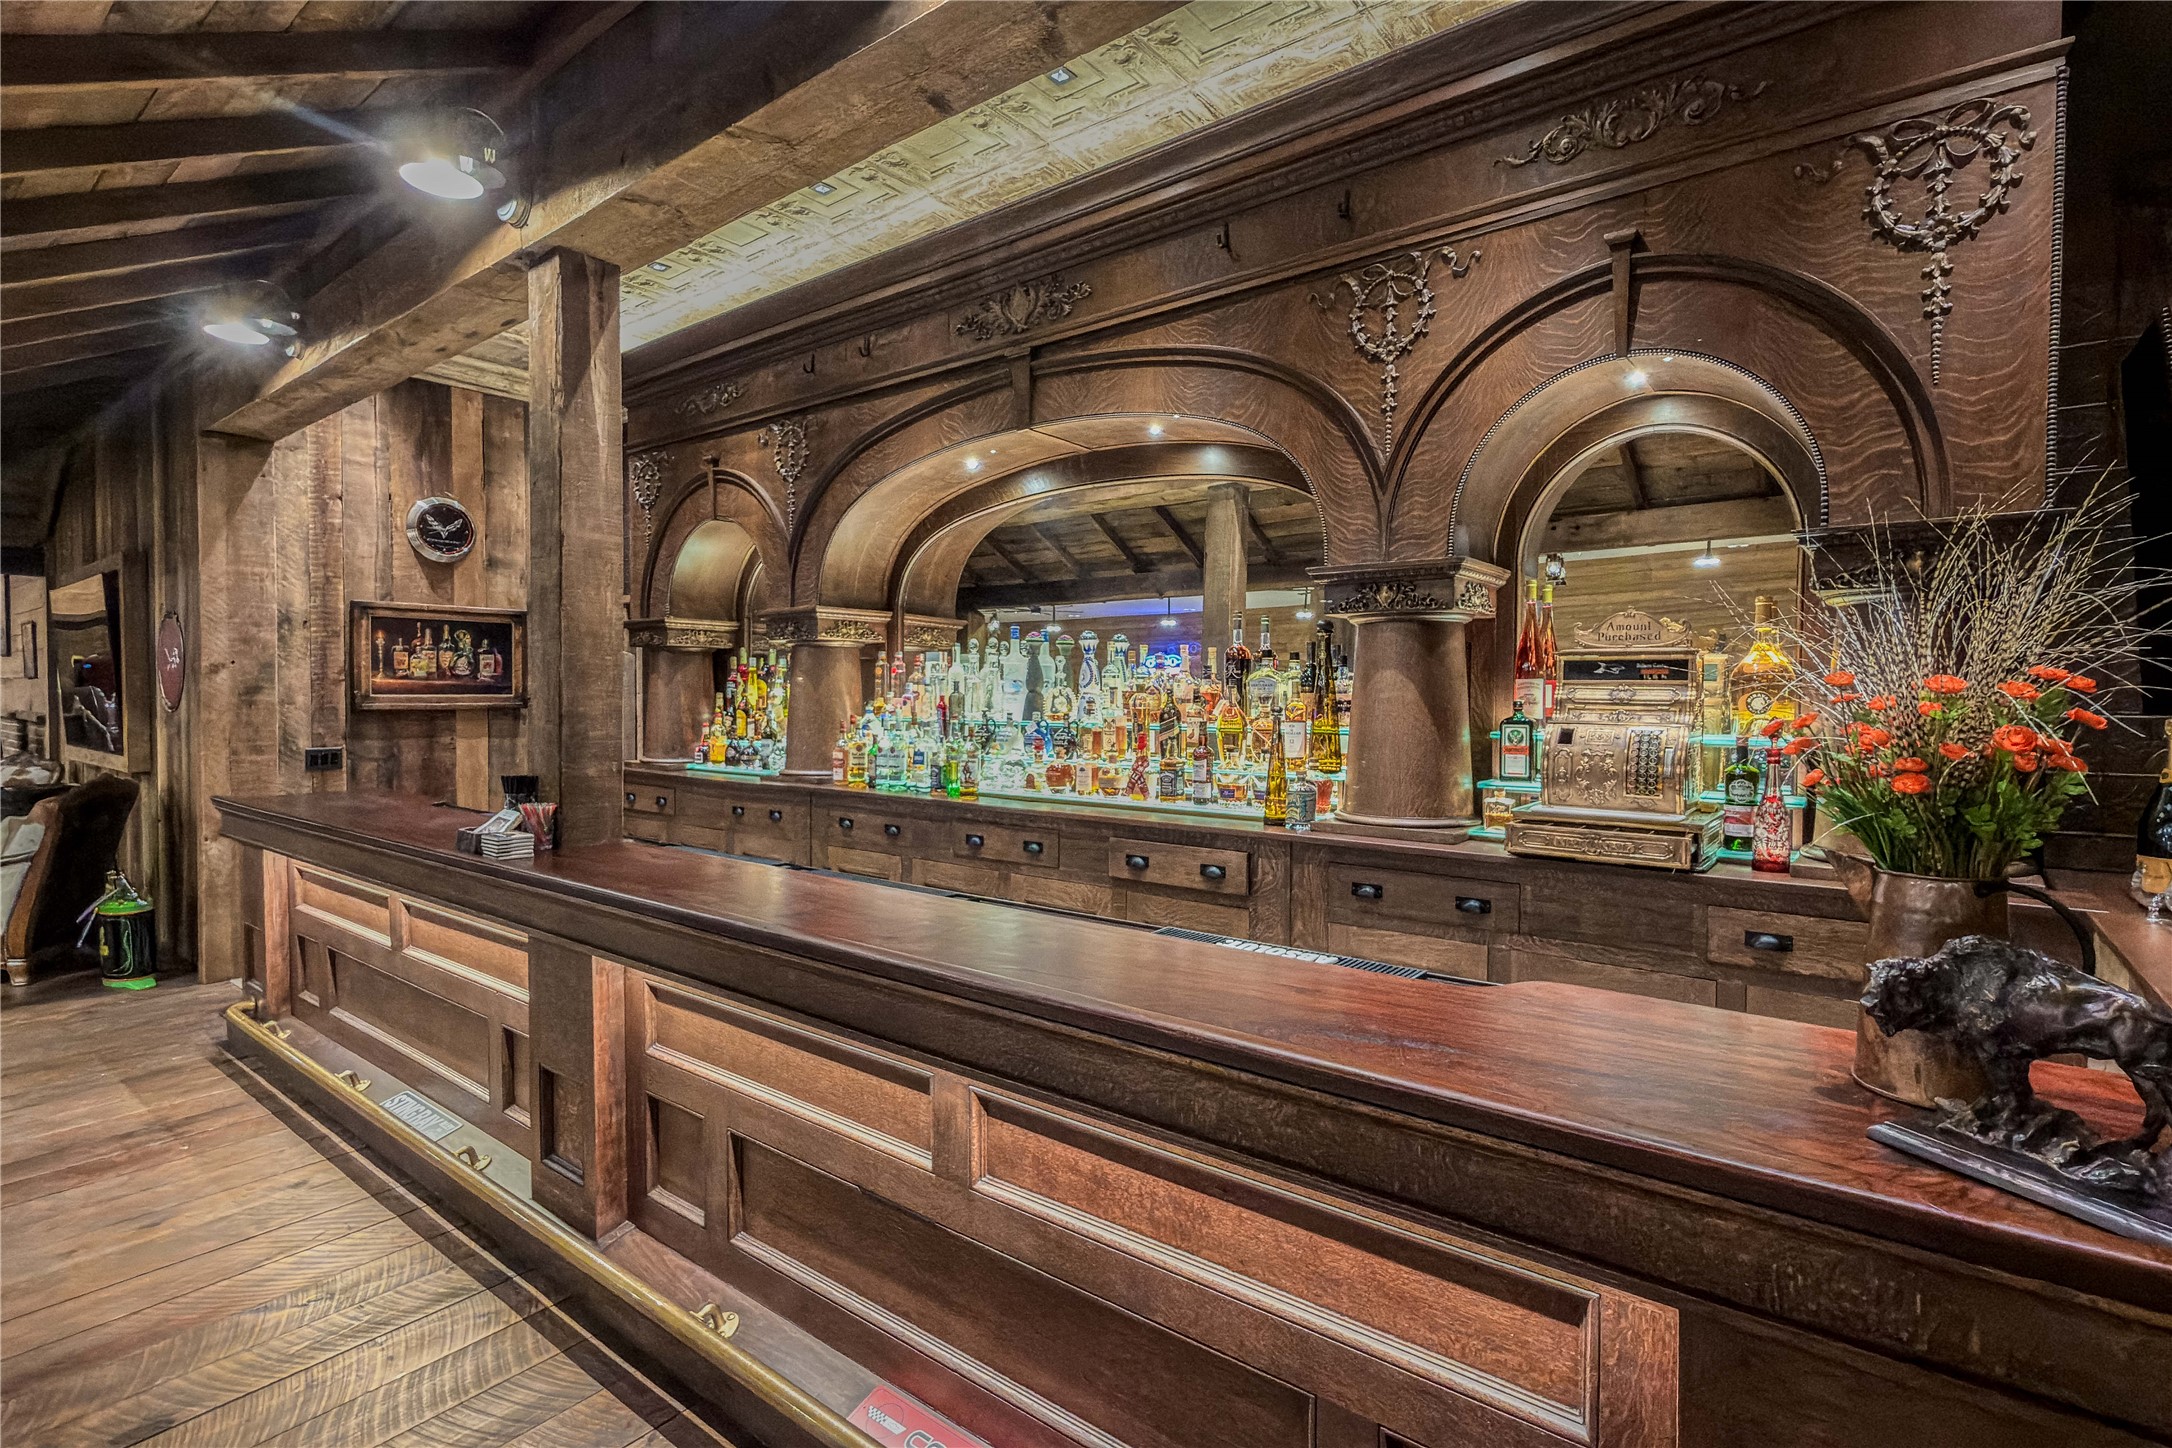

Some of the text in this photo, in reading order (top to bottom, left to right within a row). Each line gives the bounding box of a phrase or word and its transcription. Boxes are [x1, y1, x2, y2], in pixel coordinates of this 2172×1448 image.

[1606, 621, 1652, 631] Amount
[1597, 631, 1662, 642] Purchased
[1215, 939, 1340, 964] ABSOLUT
[383, 1094, 444, 1131] STINGRAY
